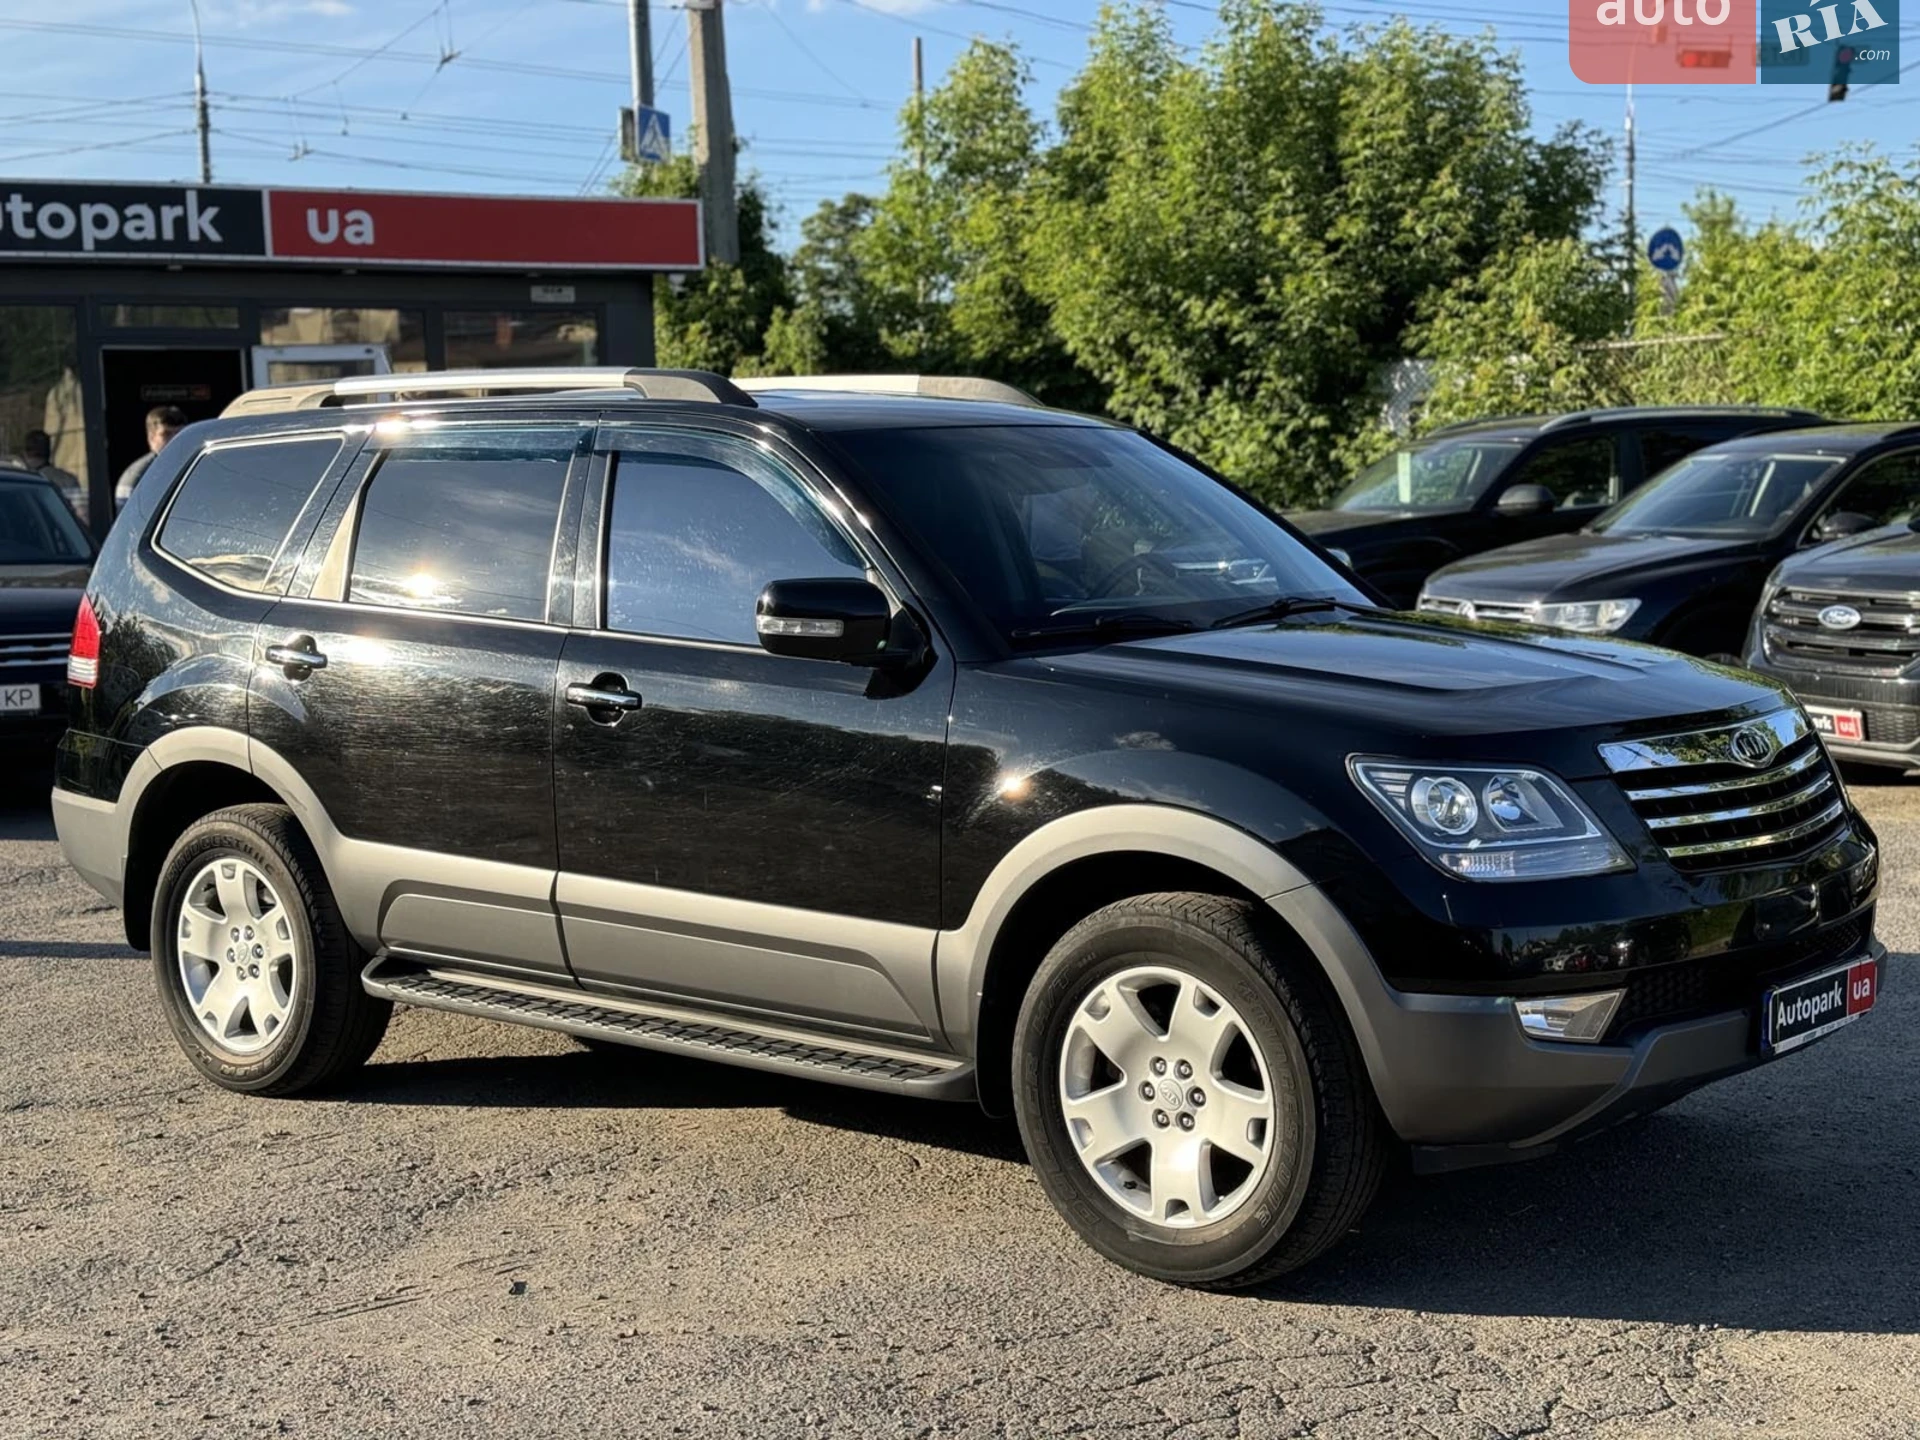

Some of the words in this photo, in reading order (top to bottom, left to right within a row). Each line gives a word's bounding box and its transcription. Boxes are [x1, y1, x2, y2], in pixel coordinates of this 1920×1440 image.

[0, 189, 223, 252] topark
[306, 207, 375, 246] ua
[4, 688, 34, 707] KP
[1776, 980, 1843, 1027] Autopark
[1853, 977, 1871, 1001] ua
